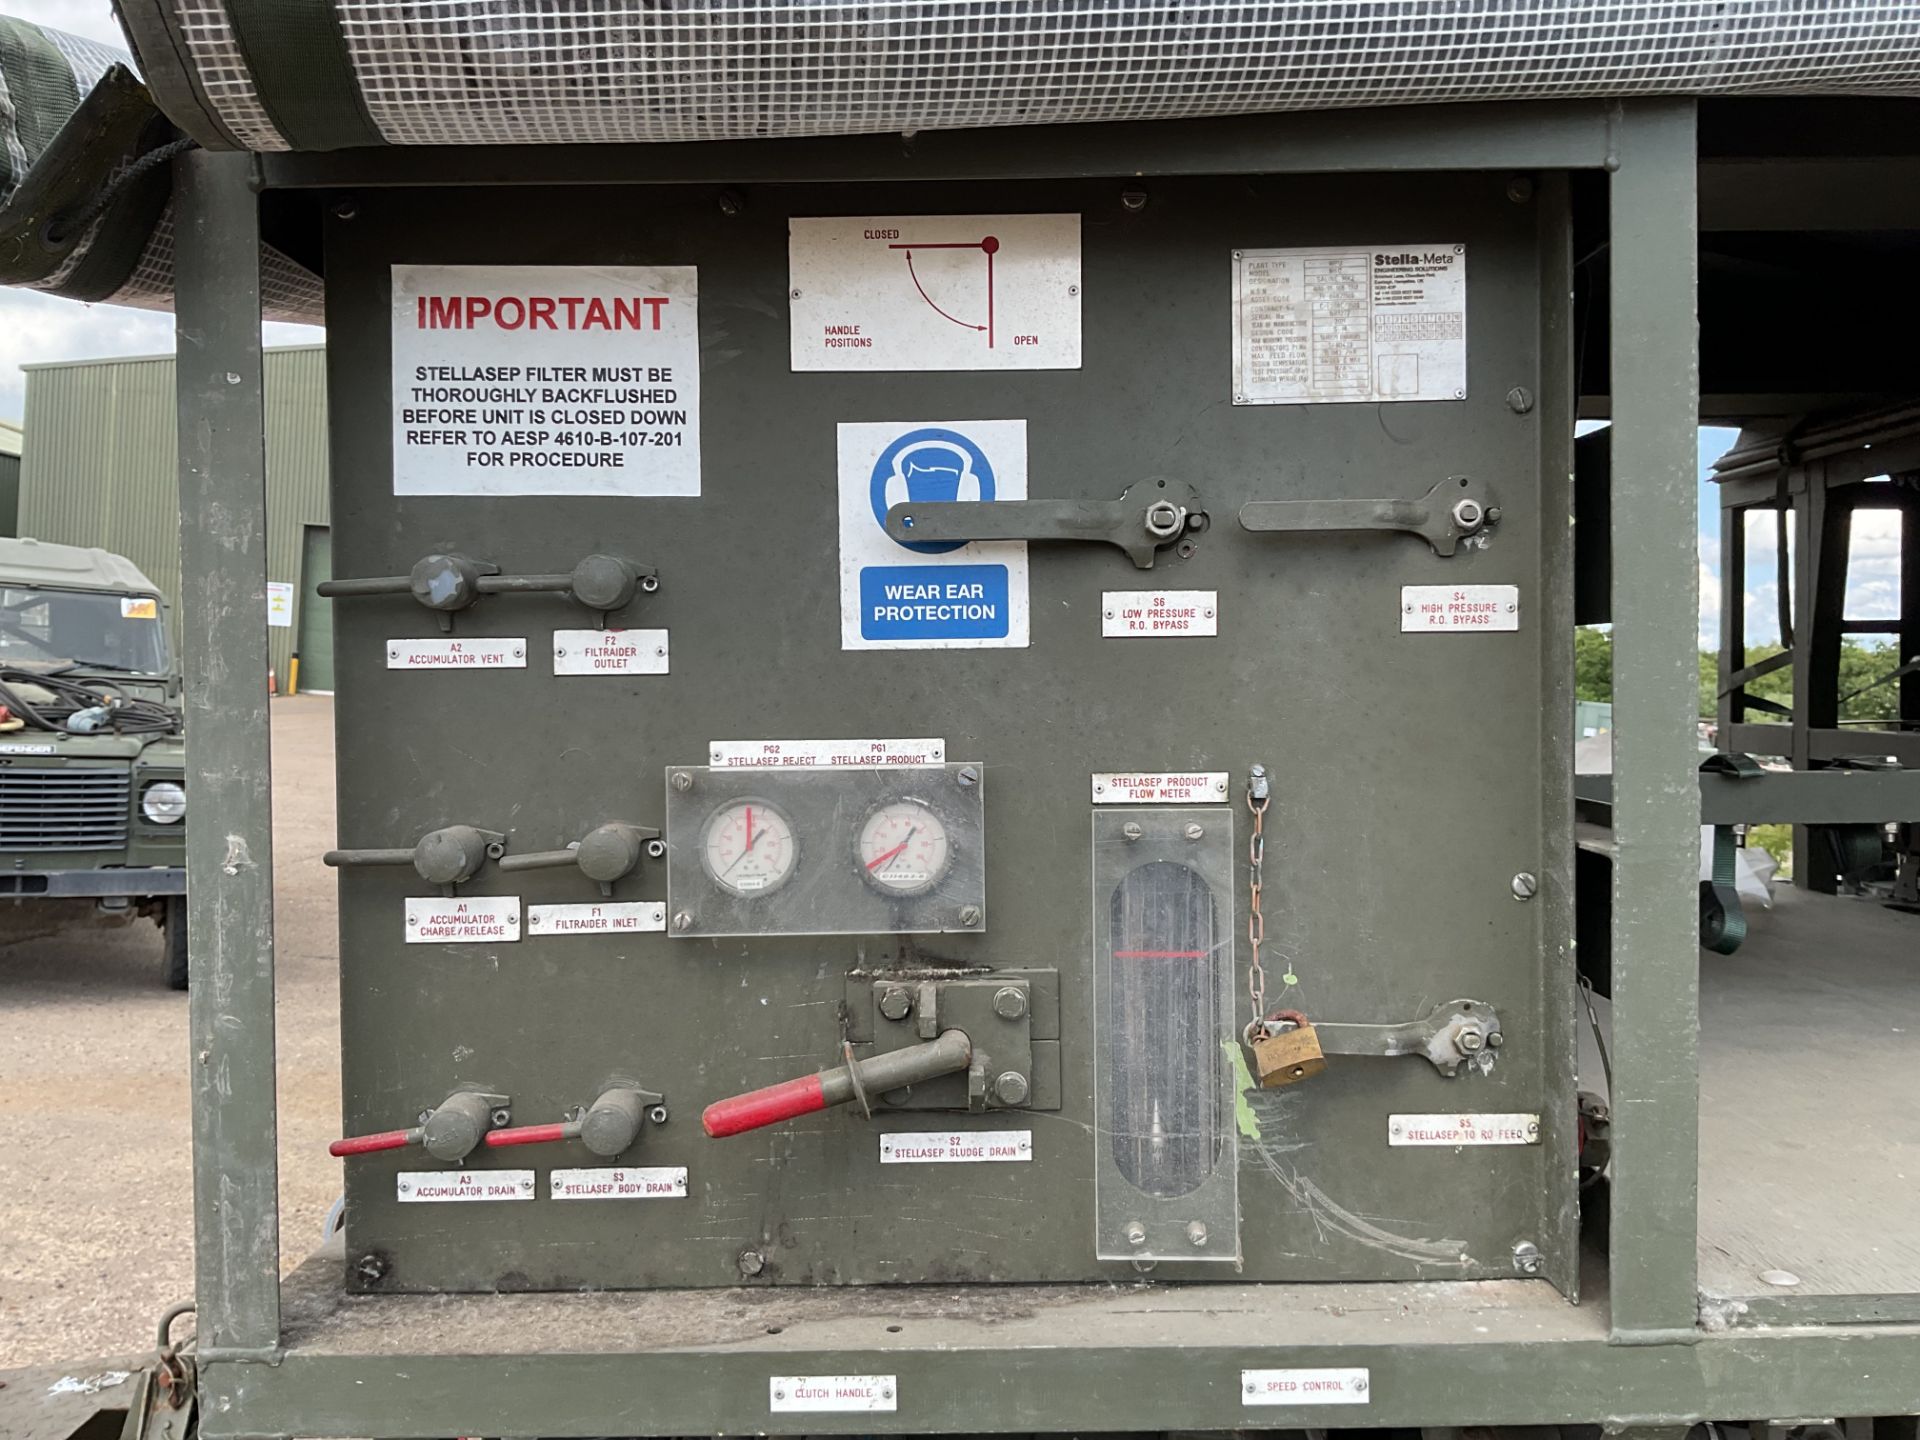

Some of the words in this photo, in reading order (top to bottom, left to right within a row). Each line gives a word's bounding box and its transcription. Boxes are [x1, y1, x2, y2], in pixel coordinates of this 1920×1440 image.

[864, 230, 900, 240] CLOSED
[1374, 253, 1454, 266] Stella-Meta
[417, 296, 670, 330] IMPORTANT
[824, 326, 860, 336] HANDLE
[824, 338, 872, 348] POSITIONS
[1014, 336, 1038, 345] OPEN
[416, 366, 520, 382] STELLASEP
[526, 367, 587, 382] FILTER
[592, 368, 642, 383] MUST
[649, 368, 672, 382] BE
[412, 388, 537, 403] THOROUGHLY
[542, 388, 677, 404] BACKFLUSHED
[403, 409, 476, 424] BEFORE
[482, 410, 524, 424] UNIT
[529, 410, 546, 424] IS
[551, 410, 626, 425] CLOSED
[631, 410, 687, 425] DOWN
[406, 430, 468, 446] REFER
[472, 430, 496, 446] TO
[502, 430, 550, 446] AESP
[554, 432, 682, 446] 4610-B-107-201
[467, 452, 504, 467] FOR
[510, 452, 624, 468] PROCEDURE
[884, 584, 940, 600] WEAR
[946, 584, 984, 599] EAR
[1454, 592, 1466, 601] S4
[1153, 598, 1166, 606] S6
[874, 604, 995, 621] PROTECTION
[1122, 609, 1142, 618] LOW
[1147, 608, 1196, 618] PRESSURE
[1421, 604, 1443, 613] HIGH
[1448, 603, 1497, 612] PRESSURE
[1453, 615, 1490, 624] BYPASS
[1153, 620, 1189, 630] BYPASS
[605, 636, 616, 645] F2
[450, 643, 462, 652] A2
[585, 647, 637, 657] FILTRAIDER
[408, 654, 476, 664] ACCUMULATOR
[481, 654, 504, 664] VENT
[594, 659, 628, 668] OUTLET
[763, 745, 780, 754] PG2
[871, 744, 886, 752] PG1
[728, 757, 779, 766] STELLASEP
[783, 756, 816, 766] REJECT
[831, 756, 882, 764] STELLASEP
[886, 755, 926, 764] PRODUCT
[1112, 778, 1162, 787] STELLASEP
[1167, 777, 1208, 786] PRODUCT
[1129, 789, 1155, 798] FLOW
[1160, 789, 1191, 798] METER
[457, 904, 468, 913] A1
[592, 908, 601, 916] F1
[429, 914, 495, 924] ACCUMULATOR
[556, 919, 608, 929] FILTRAIDER
[613, 918, 637, 927] INLET
[1460, 1119, 1472, 1128] S5
[1408, 1130, 1459, 1140] STELLASEP
[1499, 1130, 1522, 1139] FEED
[950, 1136, 961, 1146] S2
[895, 1148, 944, 1158] STELLASEP
[950, 1147, 984, 1157] SLUDGE
[990, 1147, 1016, 1156] DRAIN
[460, 1176, 472, 1185] A3
[613, 1173, 624, 1182] S3
[416, 1187, 483, 1197] ACCUMULATOR
[488, 1186, 516, 1195] DRAIN
[565, 1185, 614, 1194] STELLASEP
[618, 1184, 641, 1194] BODY
[646, 1183, 672, 1192] DRAIN
[1267, 1382, 1297, 1391] SPEED
[1303, 1381, 1343, 1391] CONTROL
[795, 1388, 830, 1398] CLUTCH
[836, 1388, 872, 1398] HANDLE
